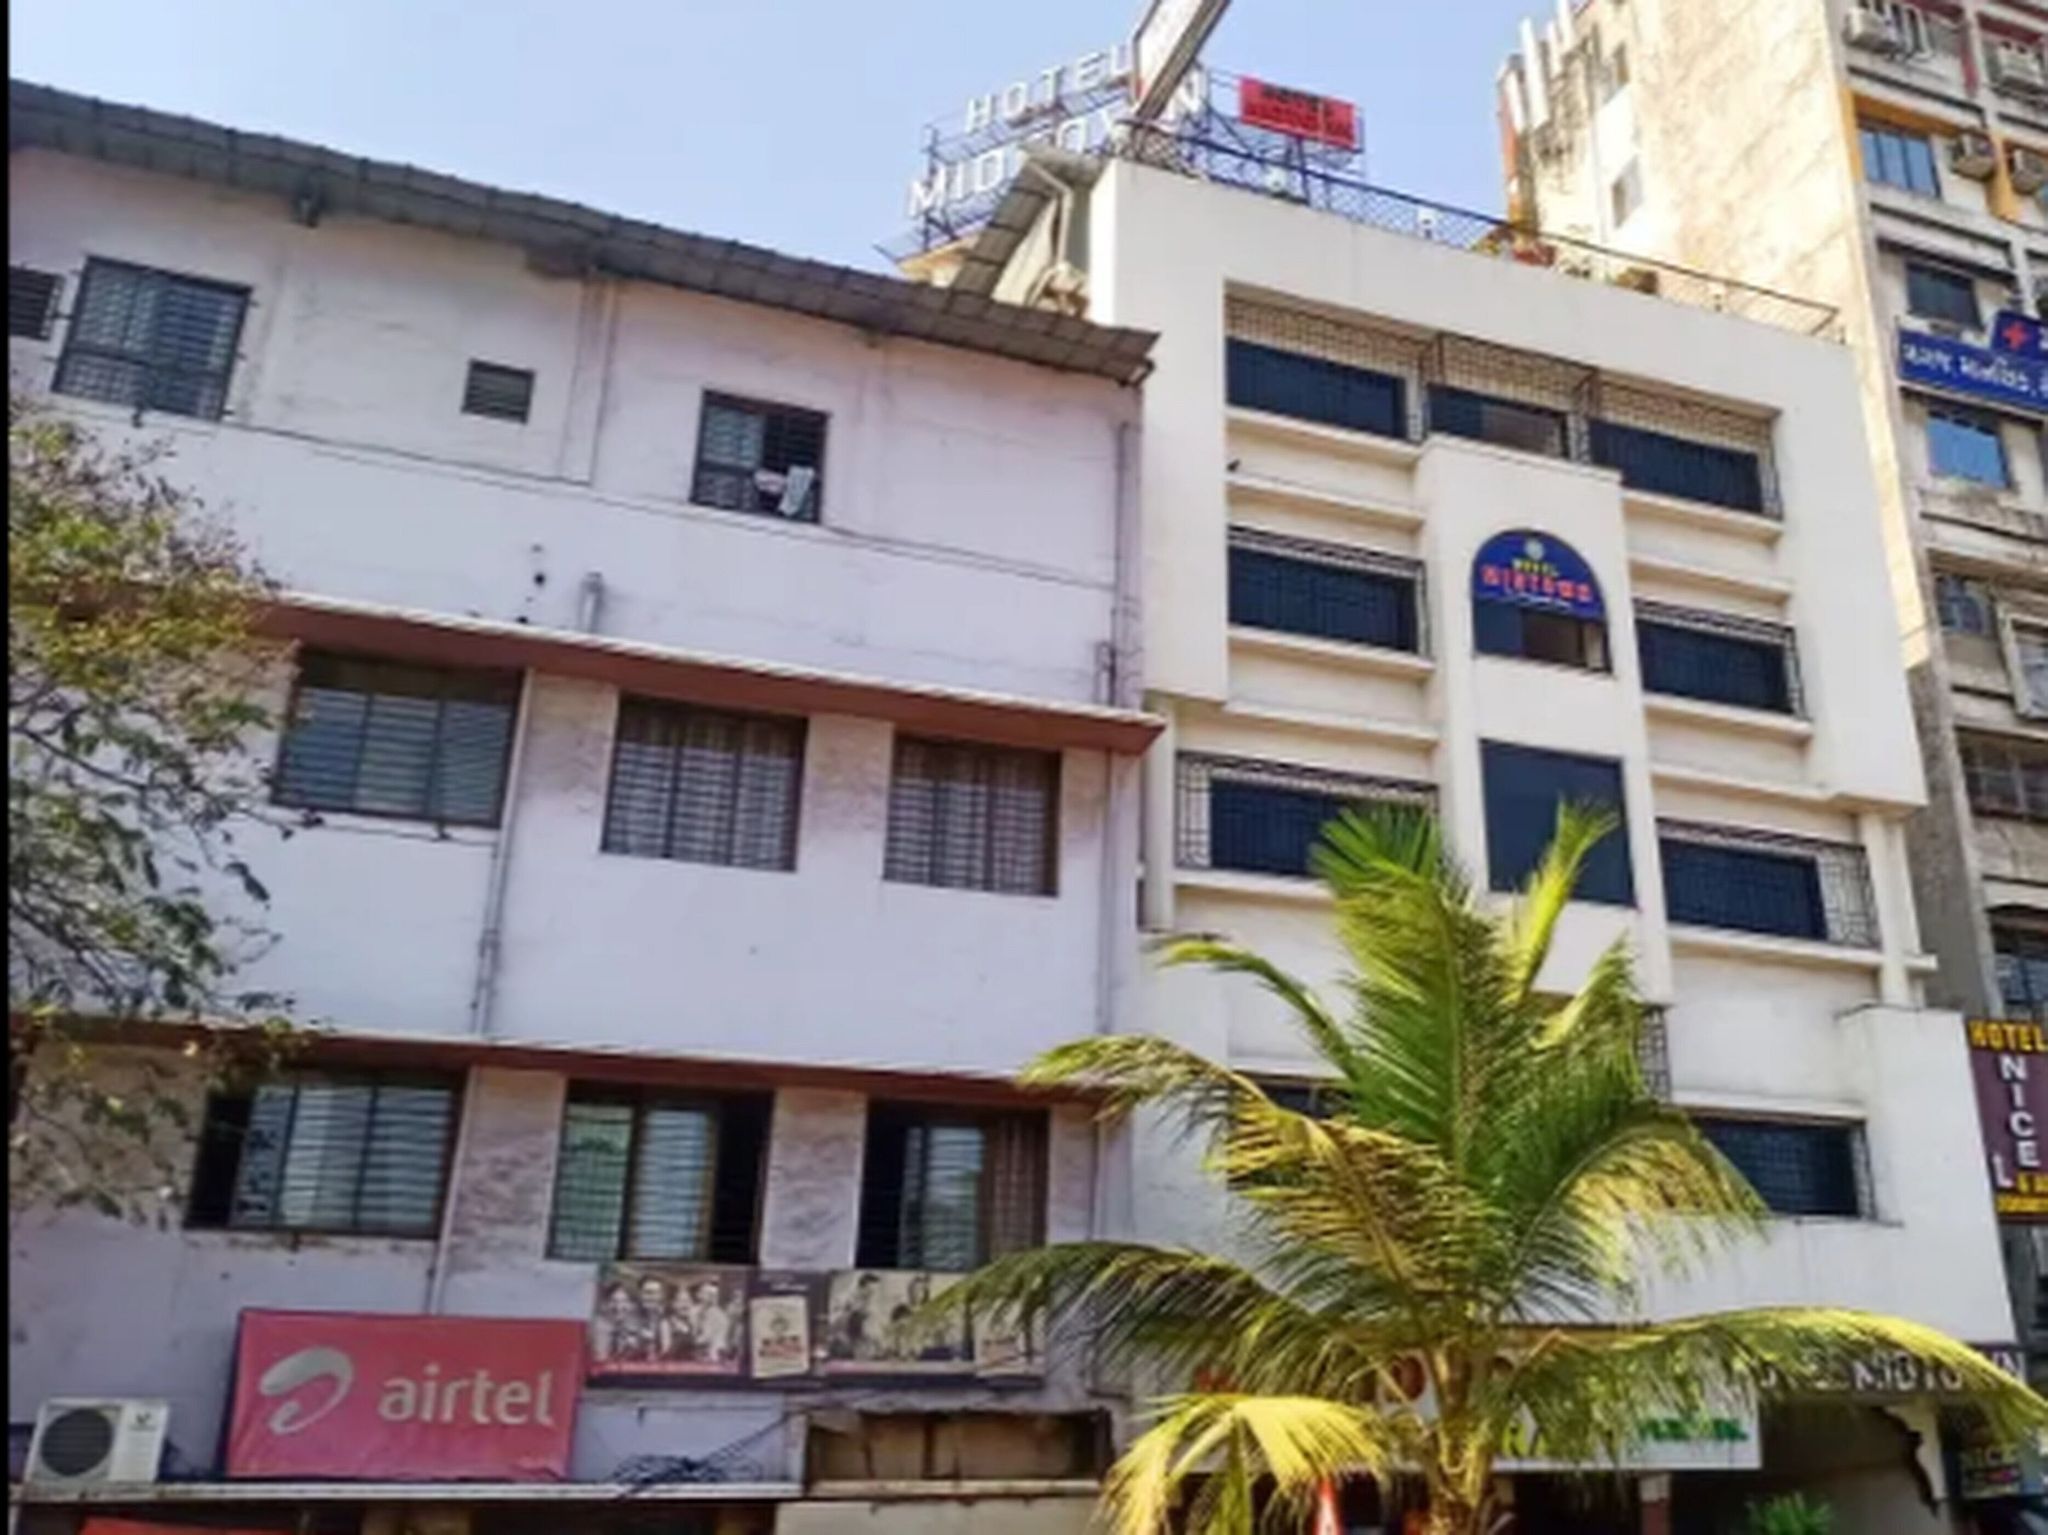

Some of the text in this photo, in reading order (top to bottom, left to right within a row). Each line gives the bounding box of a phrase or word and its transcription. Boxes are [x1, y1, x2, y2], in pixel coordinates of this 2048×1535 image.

[965, 44, 1131, 134] HOTEL
[1969, 1020, 2048, 1051] HOTEL
[2001, 1055, 2040, 1168] NICE
[378, 1363, 554, 1427] airtel
